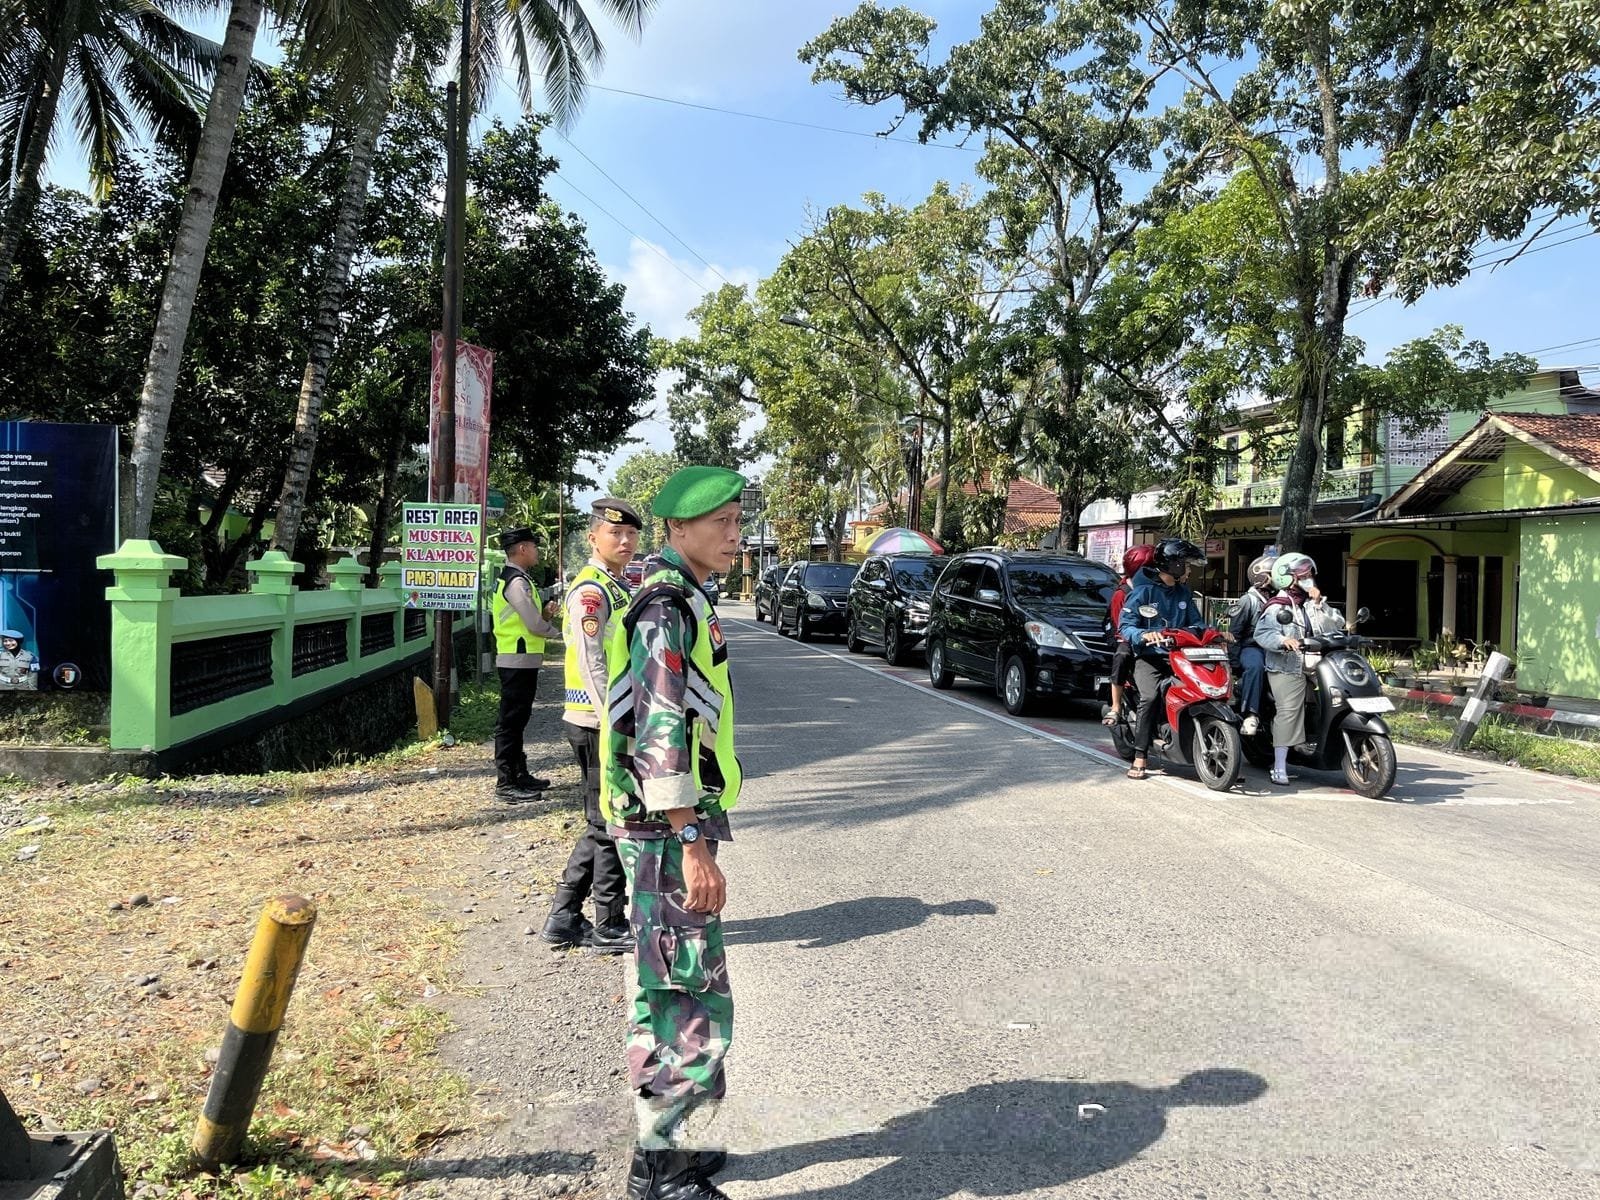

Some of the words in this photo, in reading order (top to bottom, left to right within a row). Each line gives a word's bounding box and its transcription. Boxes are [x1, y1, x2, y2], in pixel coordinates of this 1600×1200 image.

[406, 509, 439, 524] REST
[444, 510, 478, 525] AREA
[409, 530, 474, 544] MUSTIKA
[406, 548, 476, 563] KLAMPOK
[406, 569, 436, 586] PM3
[437, 571, 477, 588] MART
[420, 592, 446, 600] SEMOGA
[446, 592, 474, 601] SELAMAT
[422, 601, 447, 609] SAMPAI
